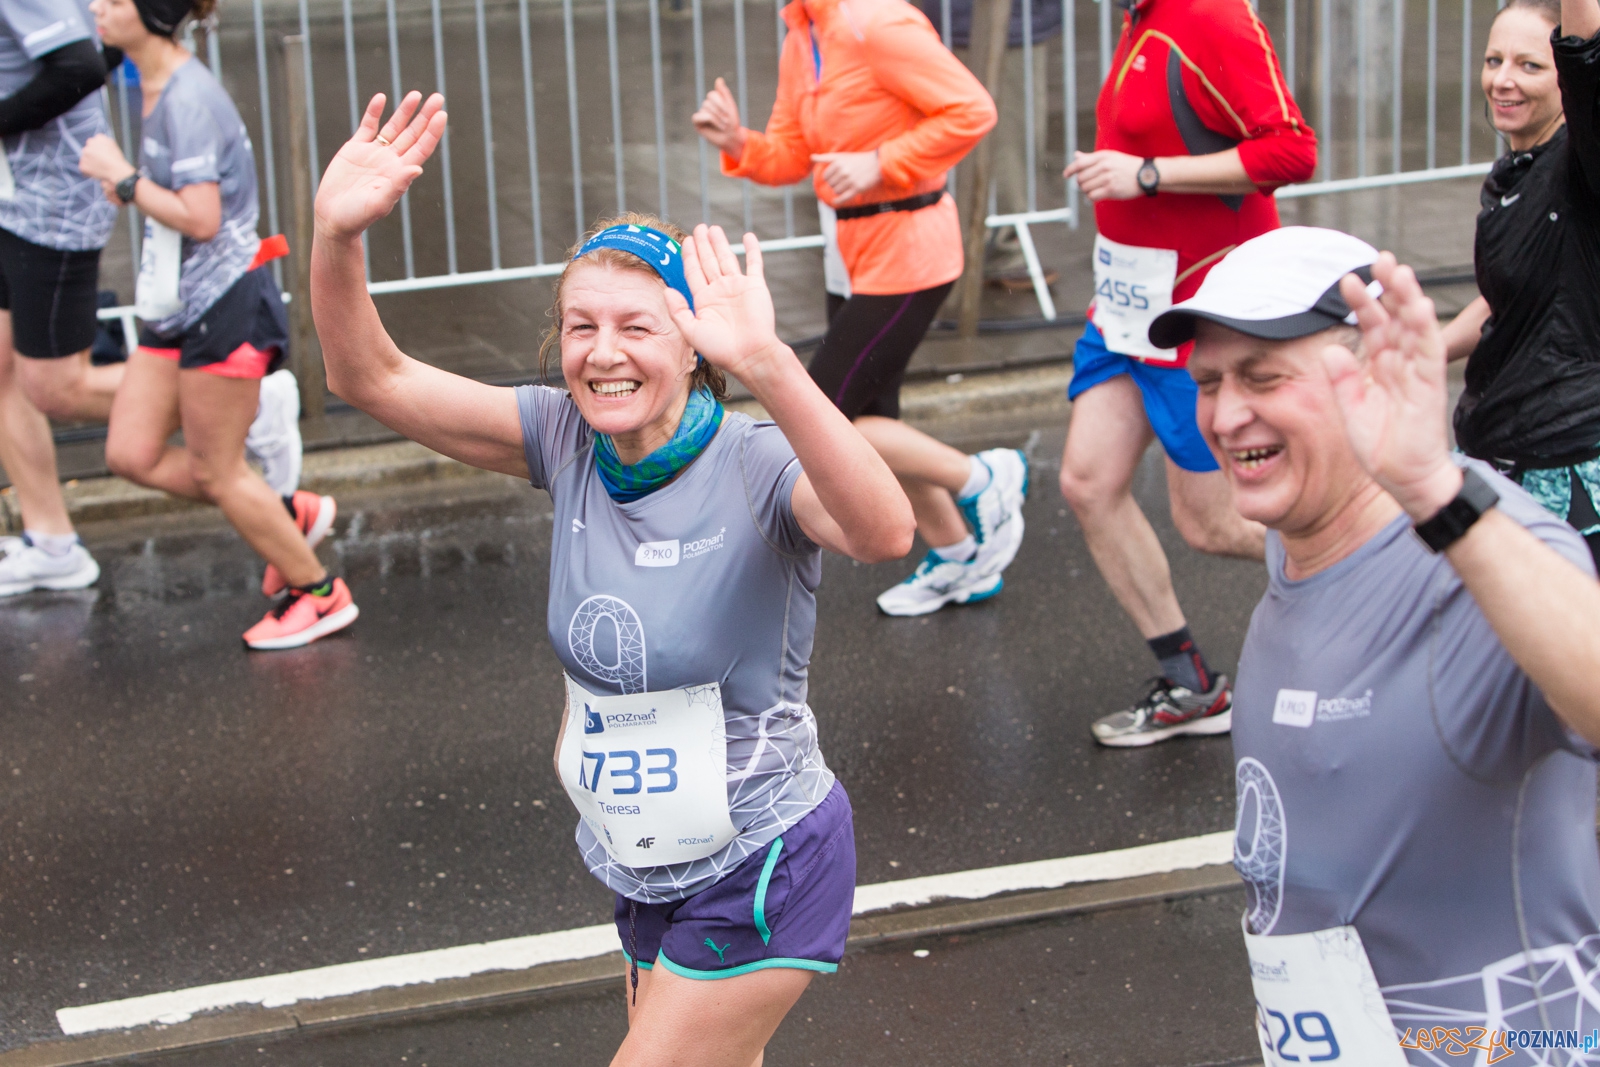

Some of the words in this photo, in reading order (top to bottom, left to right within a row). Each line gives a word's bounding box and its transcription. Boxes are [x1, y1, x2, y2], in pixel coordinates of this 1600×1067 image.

[652, 548, 673, 560] PKO
[598, 801, 641, 815] Teresa
[635, 837, 656, 849] 4F
